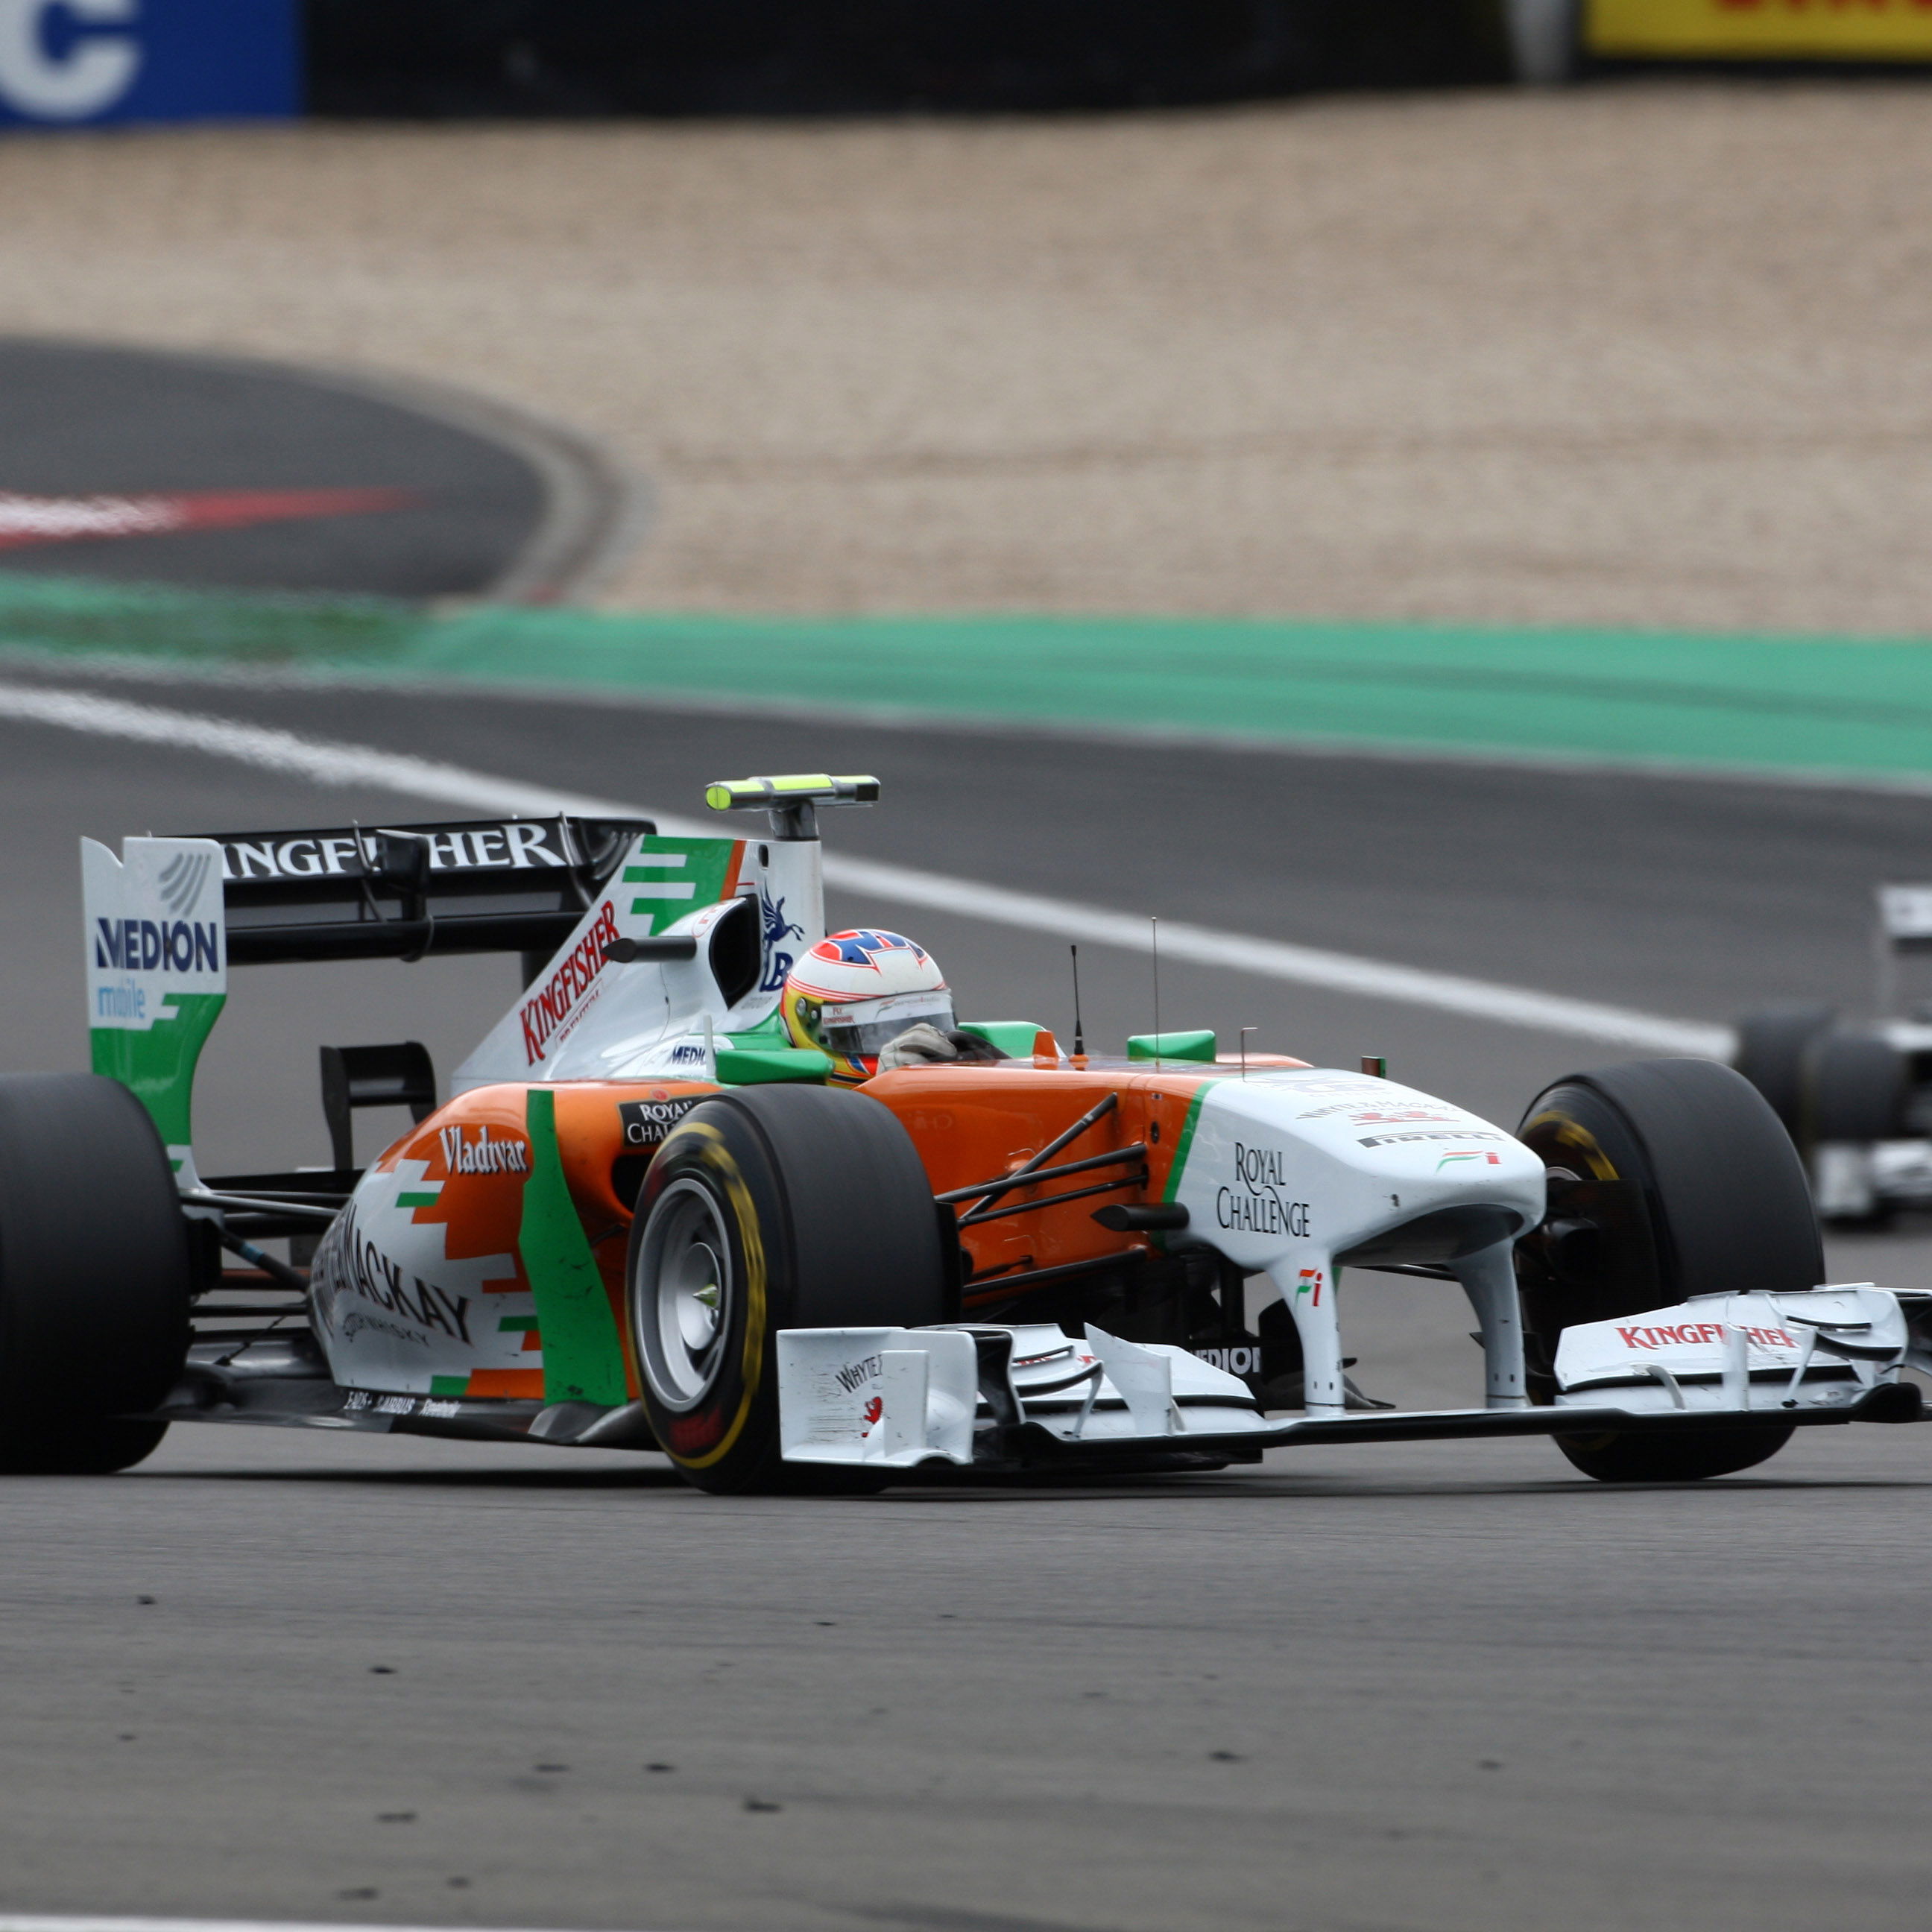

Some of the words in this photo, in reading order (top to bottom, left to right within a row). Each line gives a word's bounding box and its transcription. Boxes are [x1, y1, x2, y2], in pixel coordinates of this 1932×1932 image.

[97, 918, 218, 972] MEDION
[1235, 1142, 1287, 1193] ROYAL
[1216, 1186, 1310, 1238] CHALLENGE
